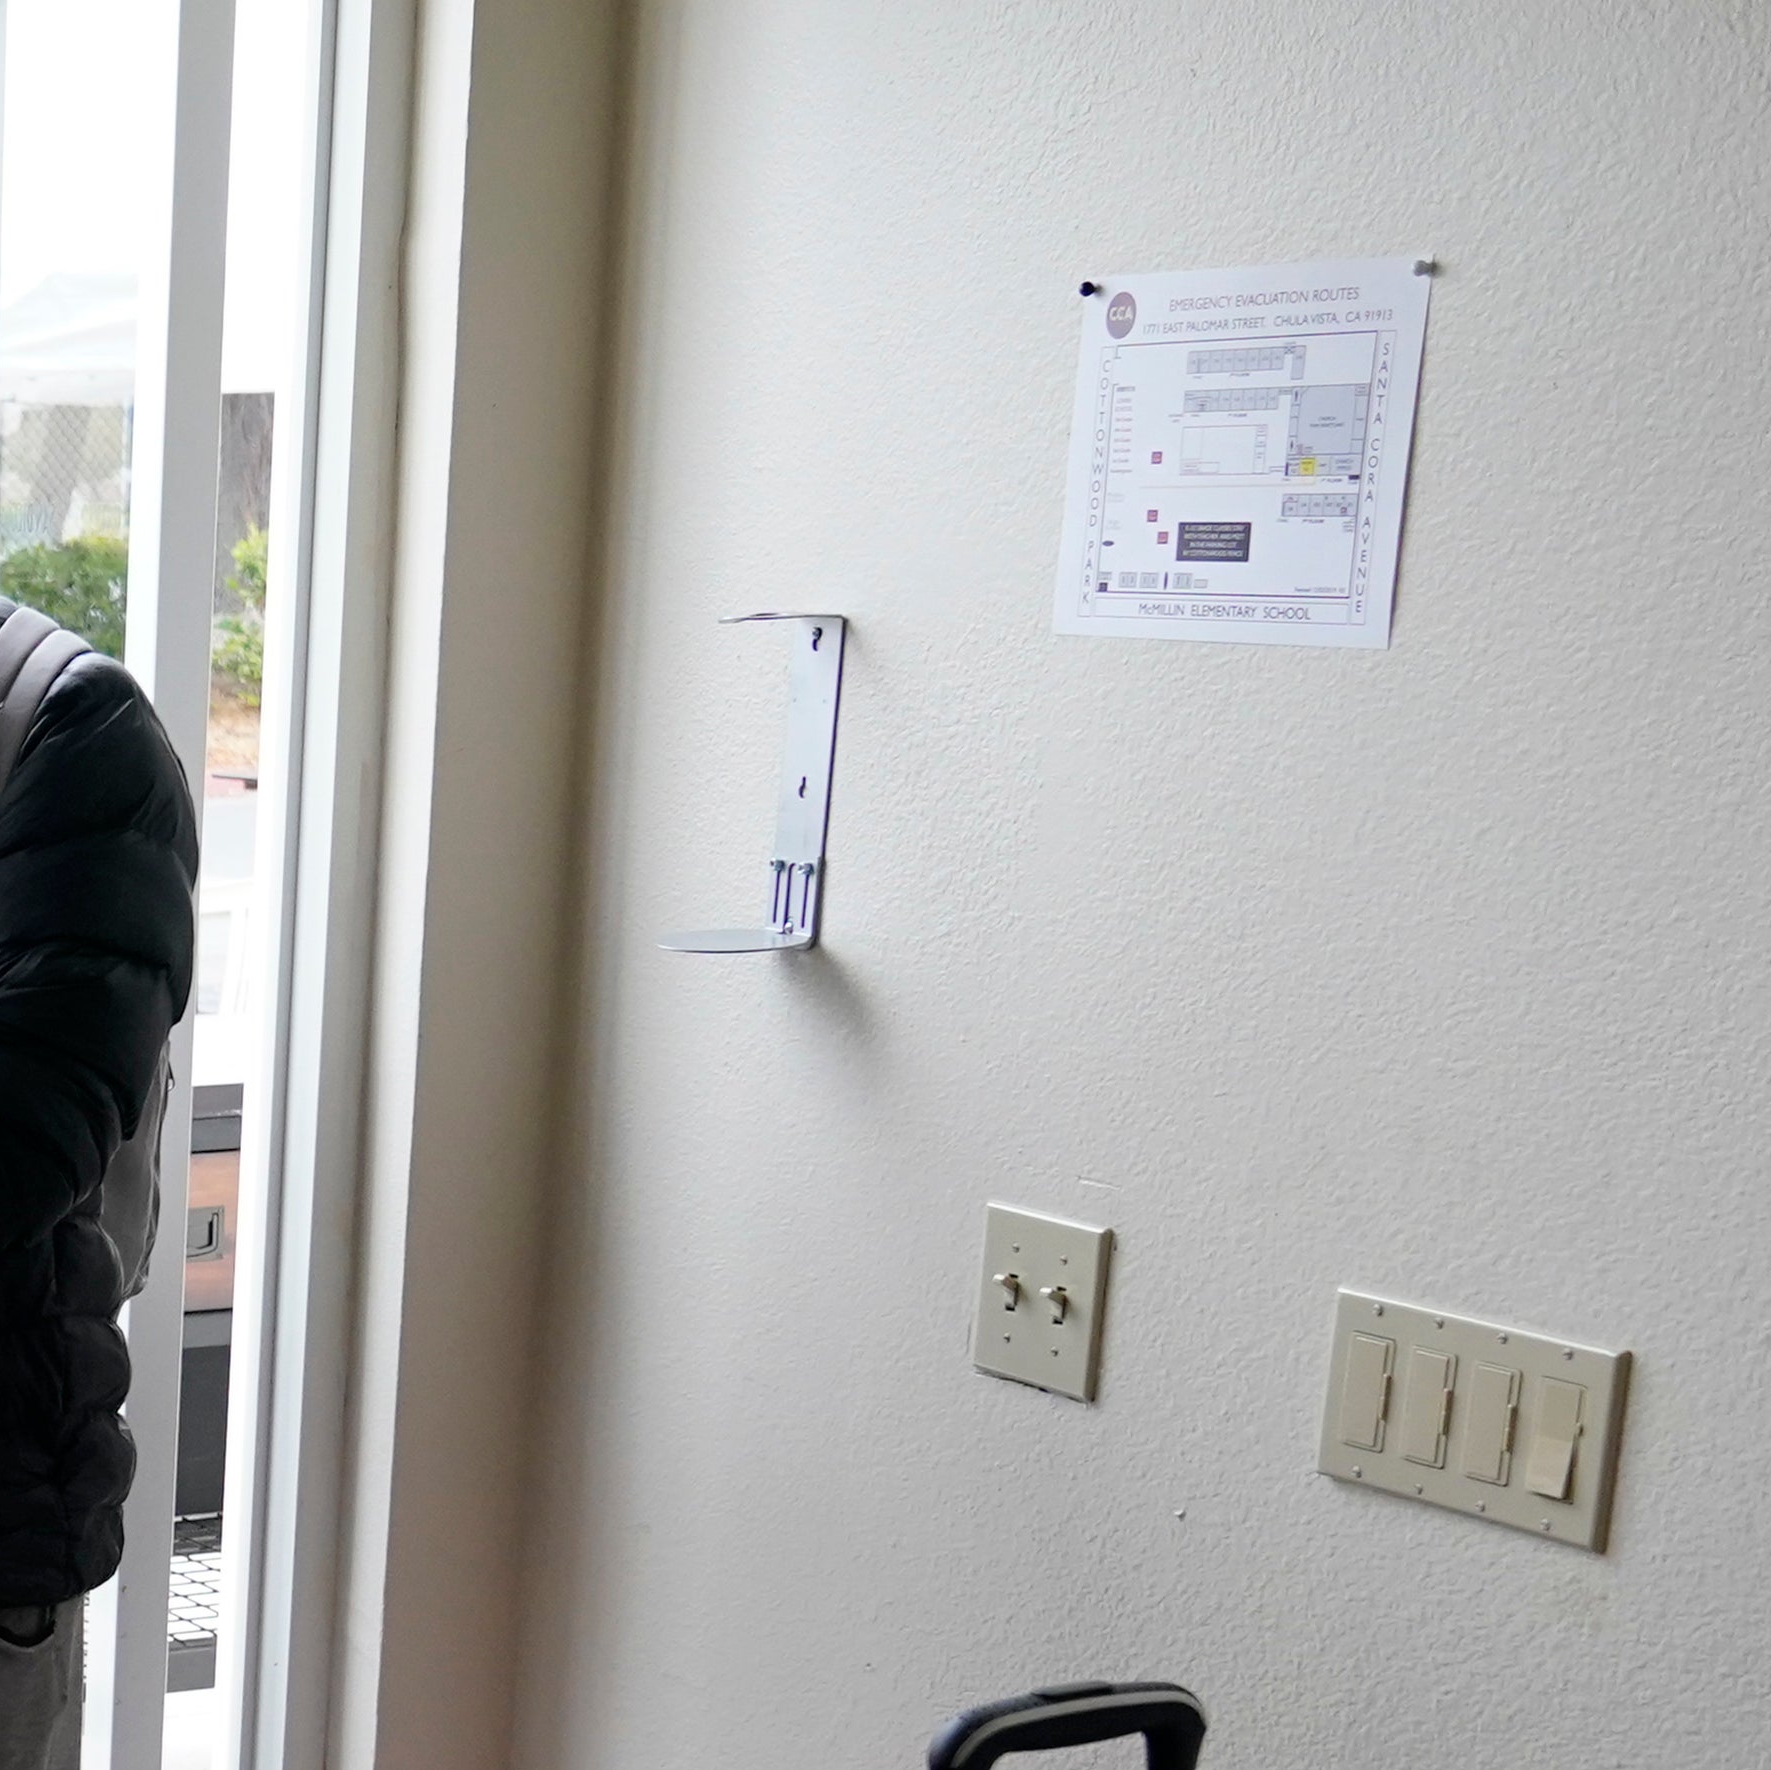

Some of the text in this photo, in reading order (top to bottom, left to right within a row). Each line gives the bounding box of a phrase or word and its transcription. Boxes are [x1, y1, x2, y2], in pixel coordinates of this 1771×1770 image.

[1169, 286, 1360, 312] EMERGENCY EVACUATION ROUTES
[1142, 320, 1161, 336] 1771
[1162, 319, 1185, 334] EAST
[1185, 317, 1230, 333] PALOMAR
[1274, 314, 1307, 328] CHULA
[1345, 311, 1362, 323] CA
[1364, 308, 1394, 321] 91913
[1082, 360, 1111, 604] COTTONWOOD PARK
[1355, 342, 1390, 613] SANTA CORA AVENUE
[1190, 604, 1257, 619] ELEMENTARY
[1263, 606, 1312, 620] SCHOOL
